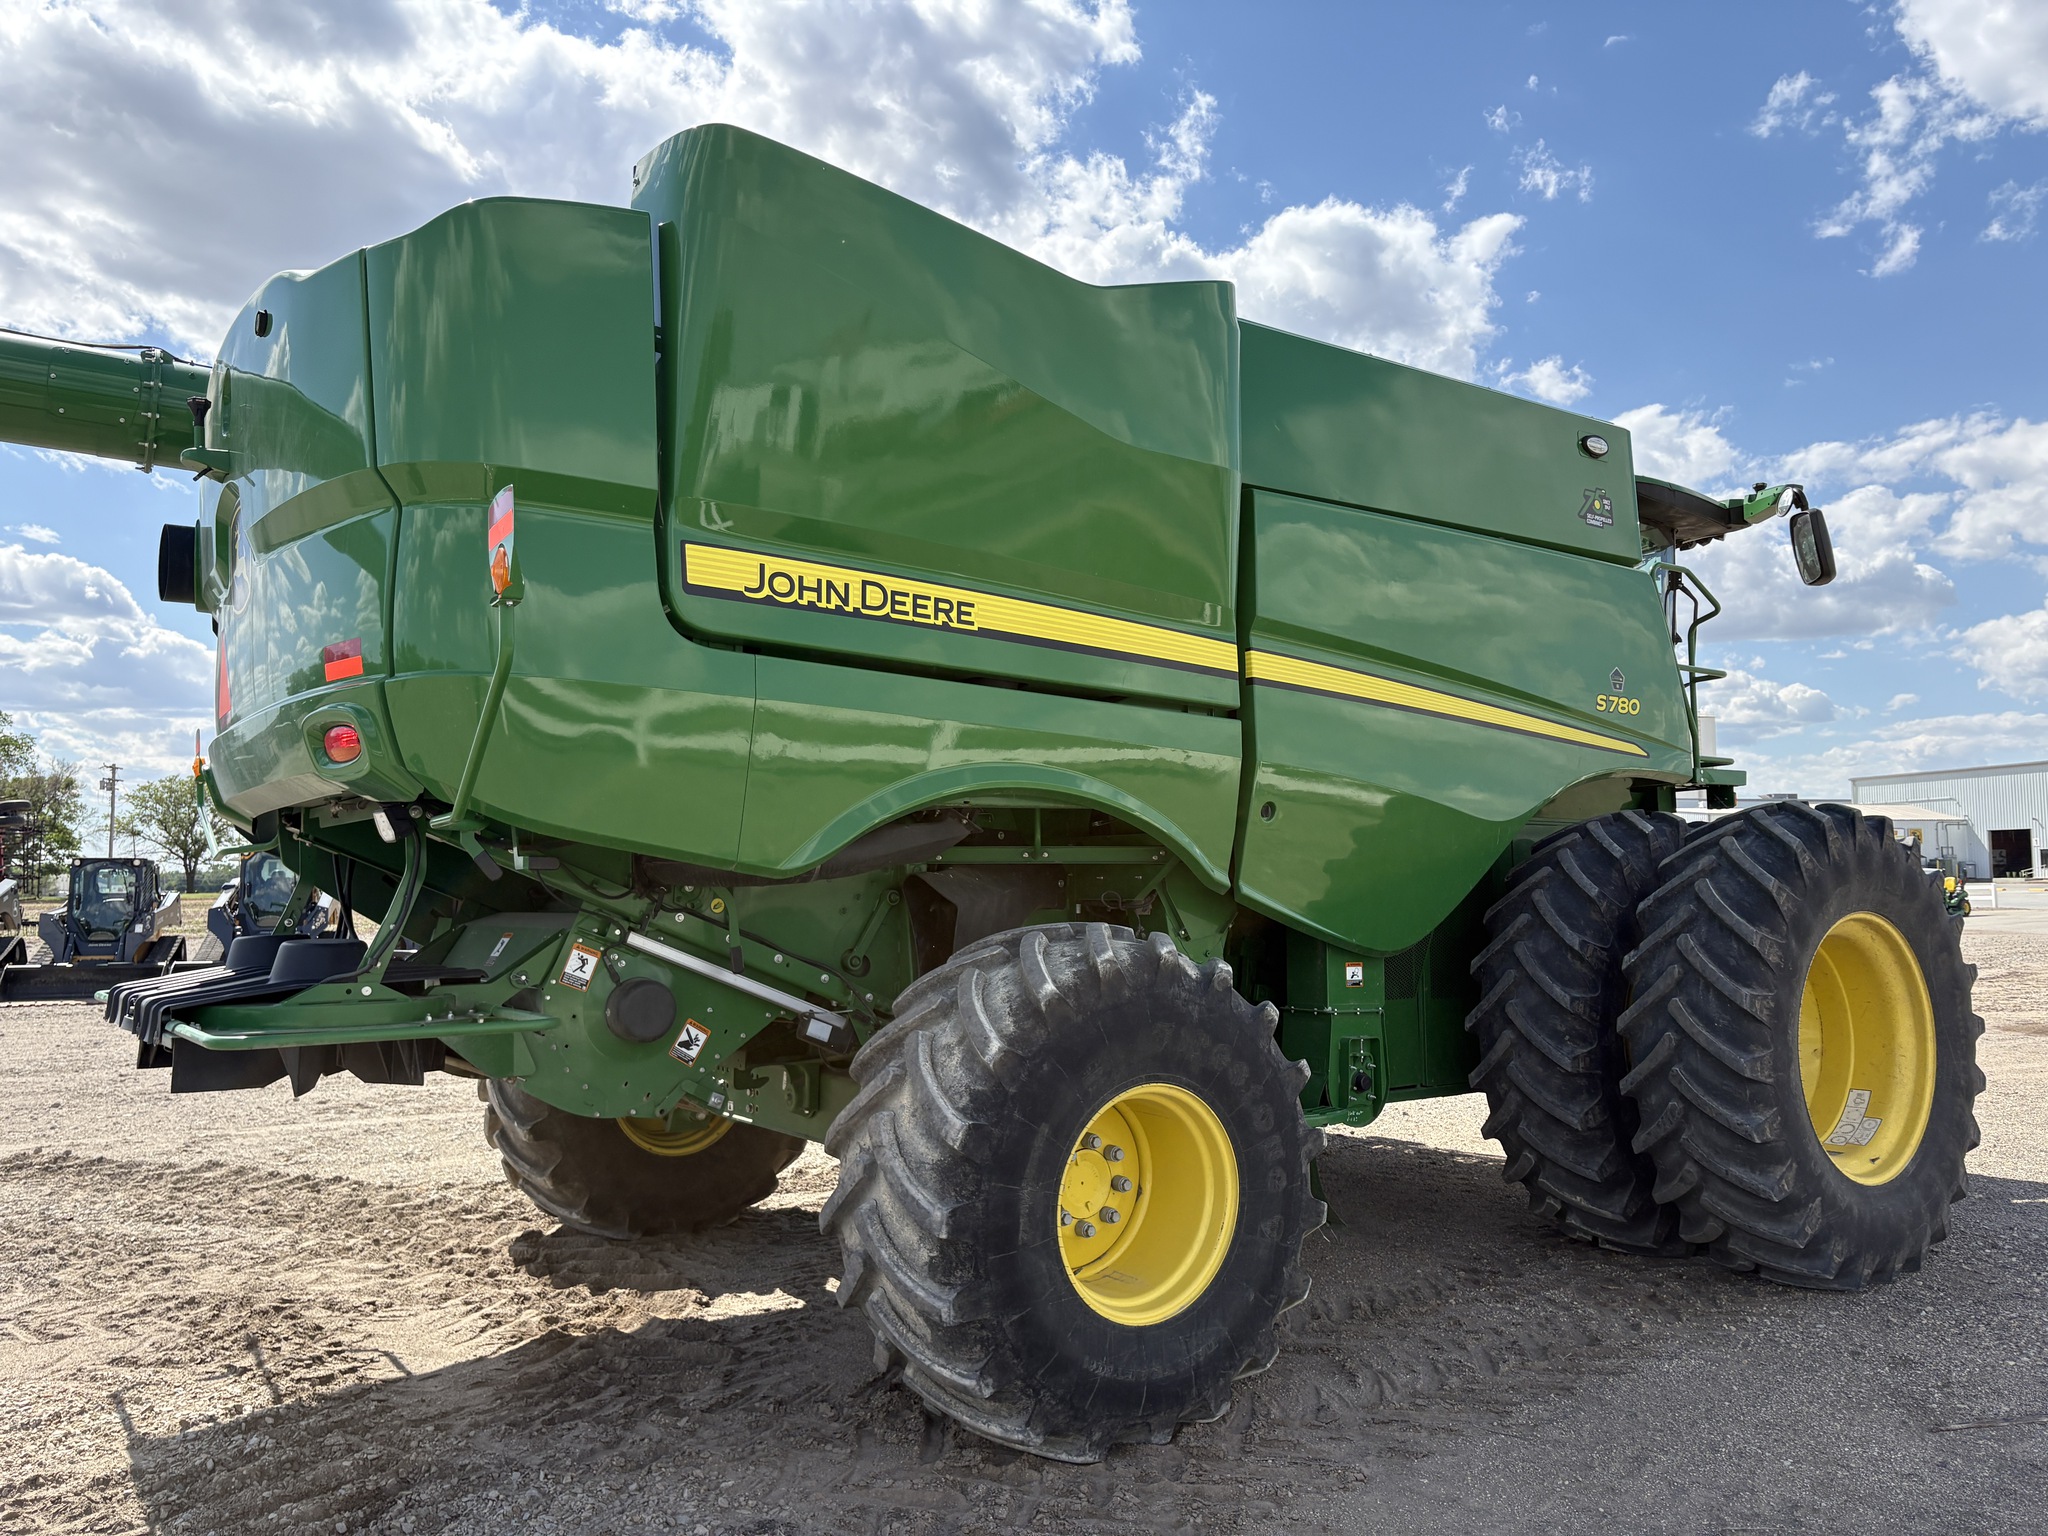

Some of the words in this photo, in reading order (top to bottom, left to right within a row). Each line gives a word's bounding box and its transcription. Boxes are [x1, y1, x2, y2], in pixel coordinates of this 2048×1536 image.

[744, 563, 851, 609] JOHN
[861, 580, 977, 628] DEERE
[1596, 694, 1640, 716] S780
